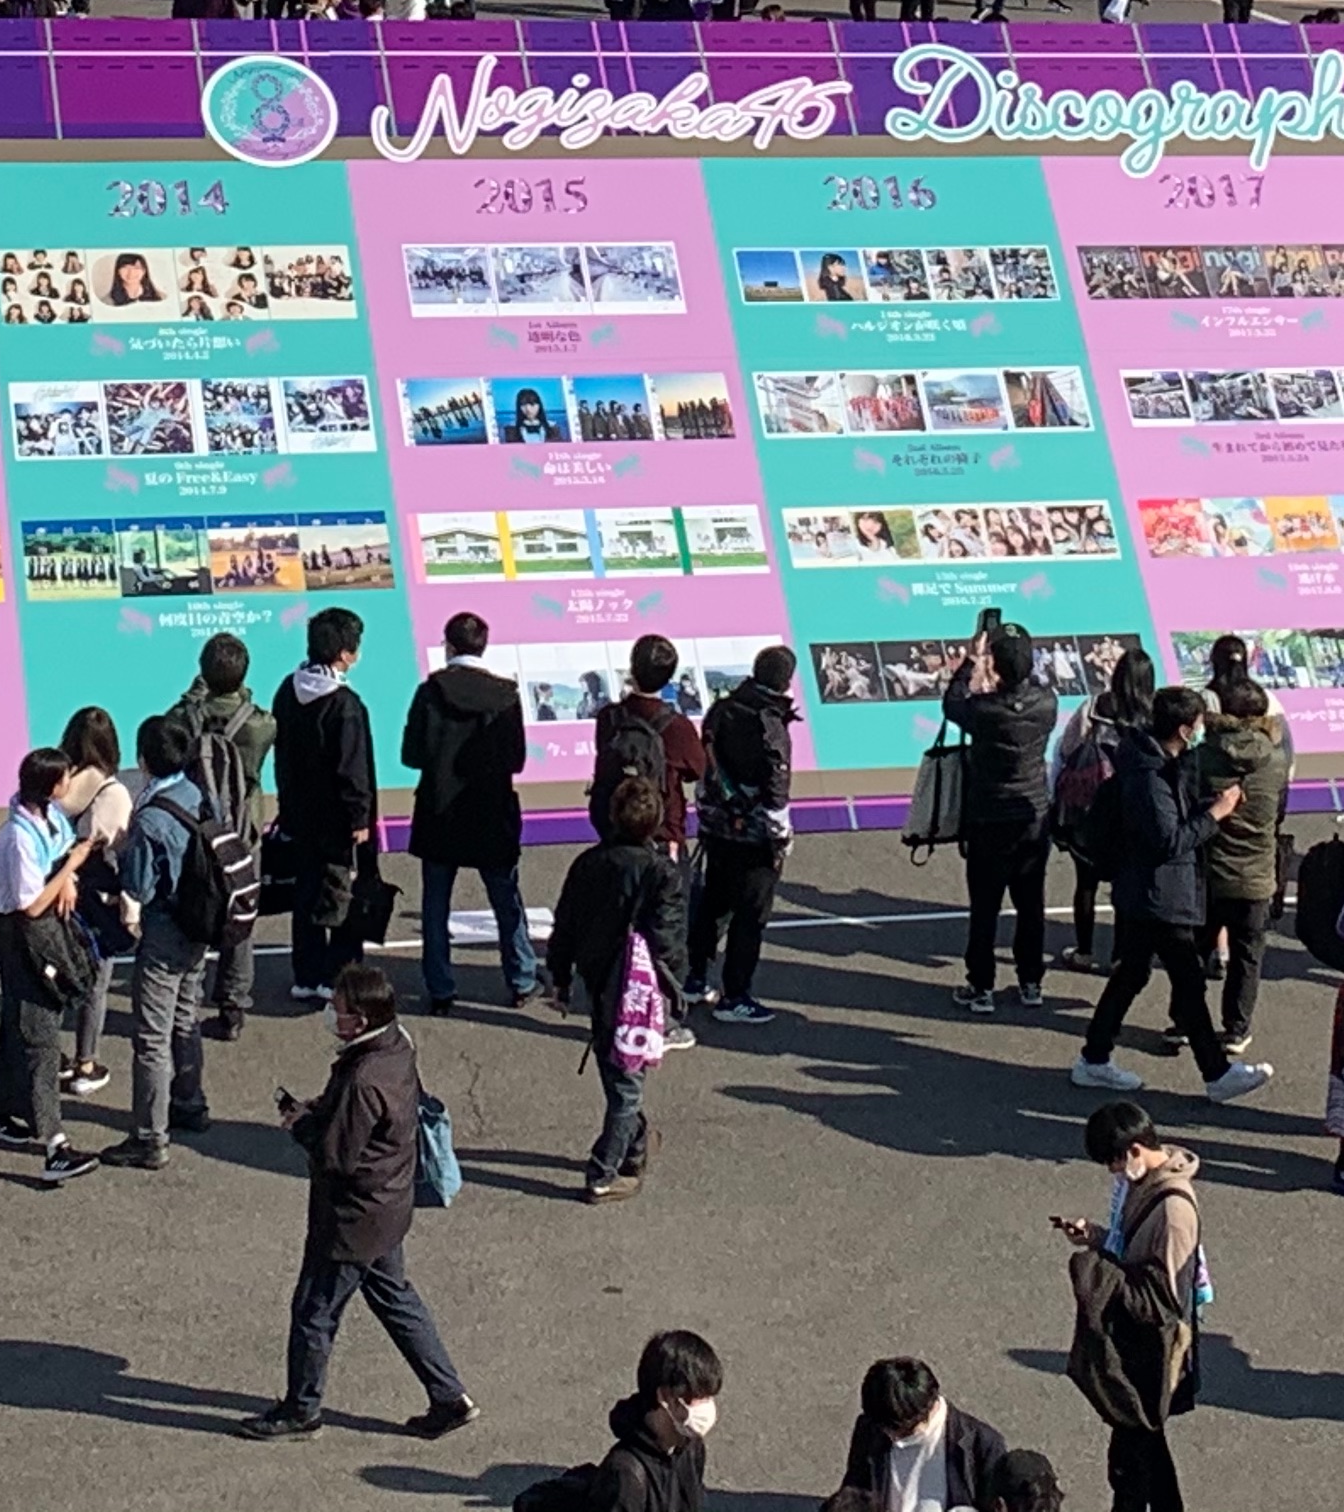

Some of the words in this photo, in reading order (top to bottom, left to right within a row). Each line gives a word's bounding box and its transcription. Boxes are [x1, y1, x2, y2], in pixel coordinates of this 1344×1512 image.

[370, 53, 853, 162] Nogizaka46
[106, 180, 229, 217] 2014
[474, 176, 588, 214] 2015
[823, 175, 937, 211] 2016
[1159, 174, 1265, 209] 2017
[128, 336, 241, 350] 気づいたら片想い
[144, 472, 173, 486] 夏の
[175, 470, 258, 485] Free&Easy
[543, 461, 612, 475] 命は美しい
[955, 581, 1018, 594] Summer
[567, 599, 634, 612] 太陽ノック
